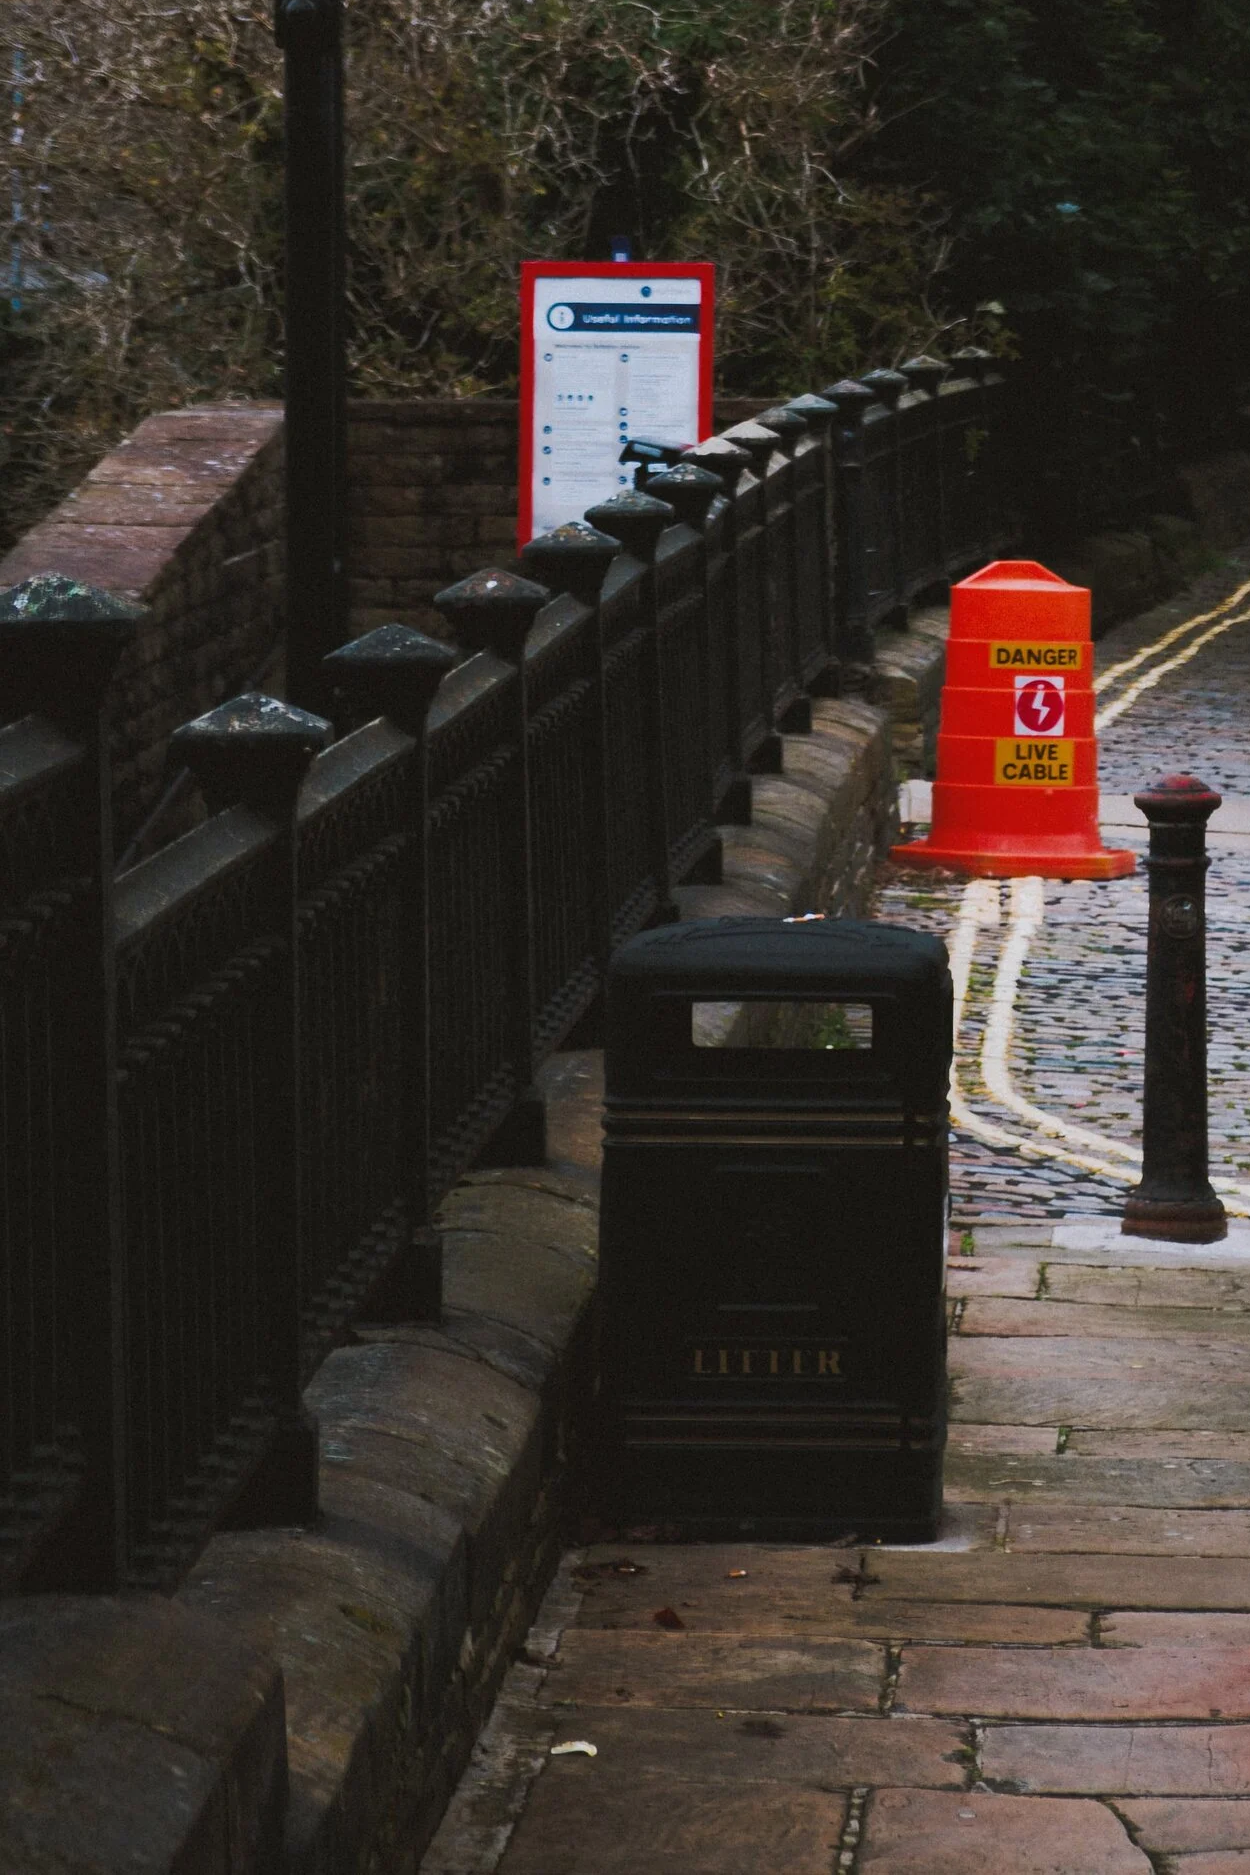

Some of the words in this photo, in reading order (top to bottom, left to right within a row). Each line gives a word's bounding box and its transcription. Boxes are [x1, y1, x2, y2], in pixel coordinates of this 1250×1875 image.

[582, 314, 619, 324] Useful
[623, 314, 692, 324] Information
[996, 648, 1078, 666] DANGER
[1015, 744, 1059, 761] LIVE
[1002, 763, 1069, 781] CABLE
[693, 1349, 842, 1374] LITTER
